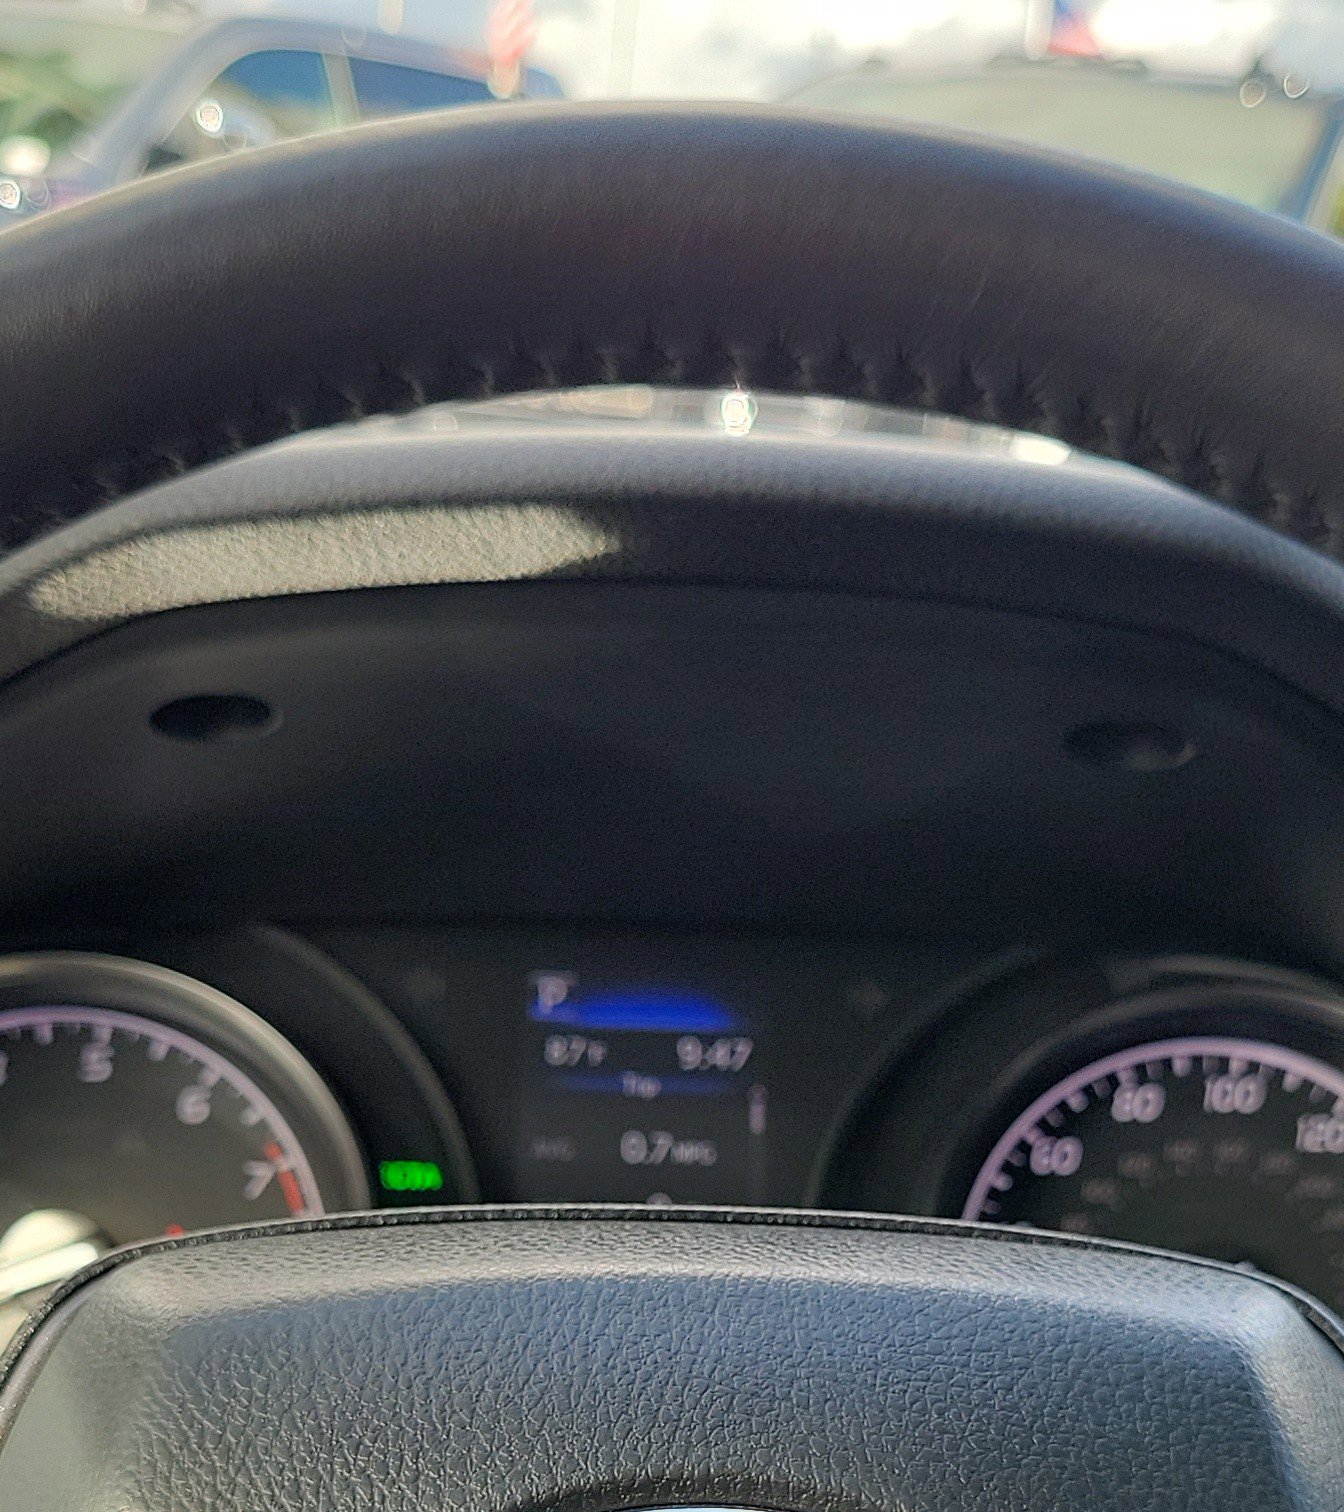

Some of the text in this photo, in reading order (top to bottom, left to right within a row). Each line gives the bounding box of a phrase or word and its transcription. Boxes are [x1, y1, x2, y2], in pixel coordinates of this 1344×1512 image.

[1111, 1083, 1164, 1122] 80
[1204, 1073, 1265, 1114] 100
[1031, 1136, 1082, 1175] 60
[244, 1160, 276, 1199] 7
